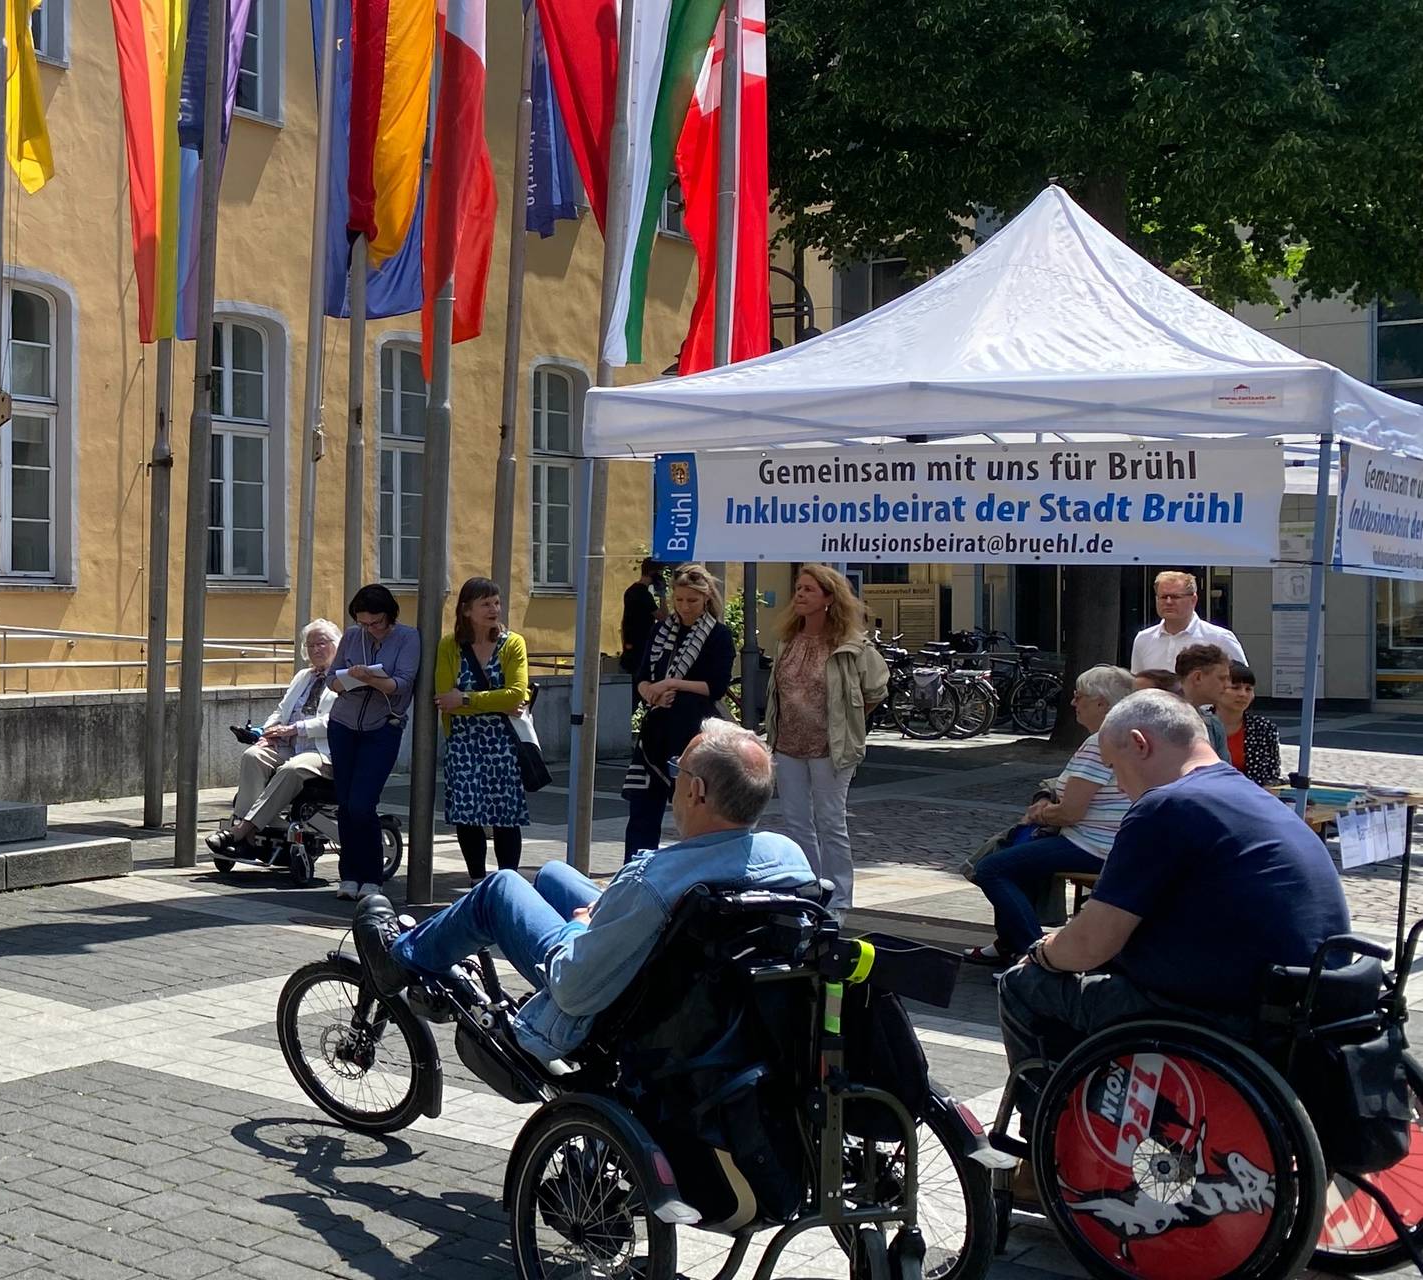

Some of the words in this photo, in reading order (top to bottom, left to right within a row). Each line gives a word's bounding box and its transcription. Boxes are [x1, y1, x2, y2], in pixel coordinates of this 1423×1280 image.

[759, 456, 916, 484] Gemeinsam
[927, 454, 977, 481] mit
[987, 458, 1039, 481] uns
[1050, 452, 1097, 481] für
[1108, 450, 1197, 480] Brühl
[666, 493, 692, 551] Brühl
[726, 493, 967, 524] Inklusionsbeirat
[975, 493, 1031, 522] der
[1040, 492, 1133, 522] Stadt
[1142, 492, 1244, 523] Brühl
[821, 532, 1114, 555] inklusionsbeirat@bruehl.de
[1099, 1059, 1127, 1124] KÖLN
